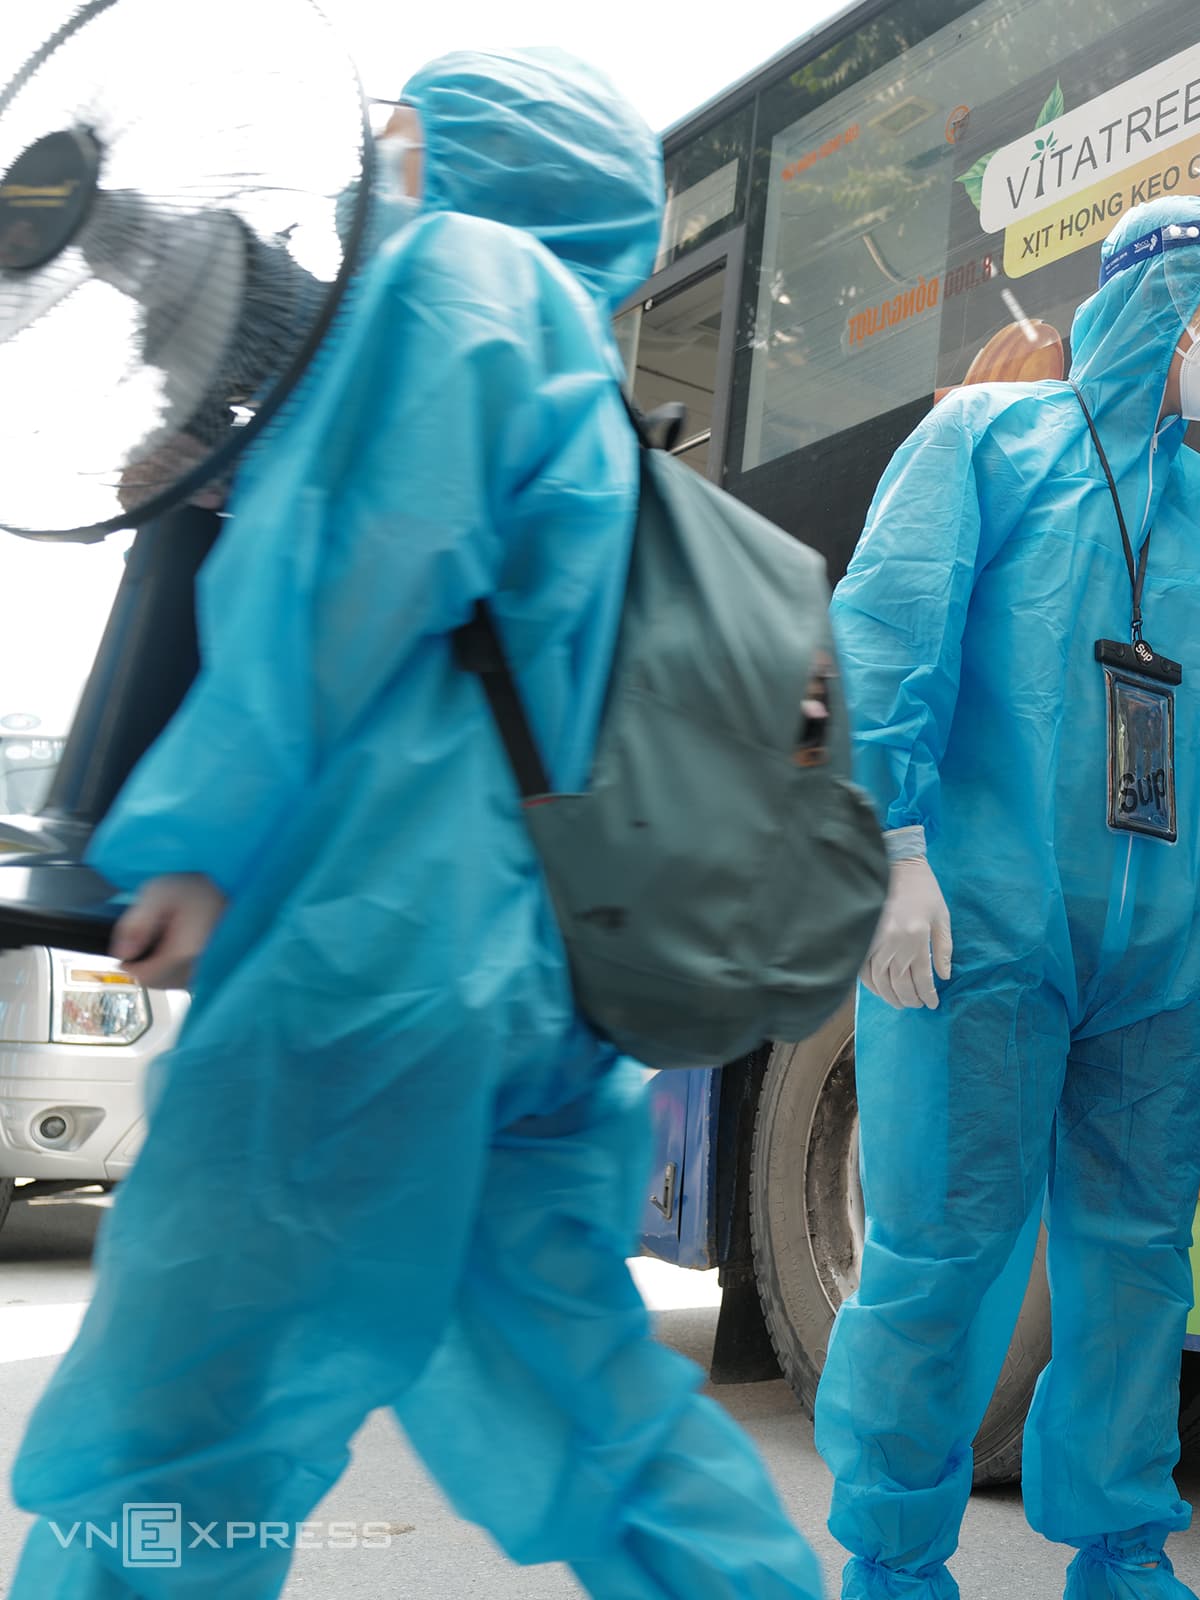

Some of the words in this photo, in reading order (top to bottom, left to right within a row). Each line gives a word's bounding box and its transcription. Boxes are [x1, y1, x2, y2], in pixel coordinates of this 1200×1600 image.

[1020, 223, 1055, 260] XỊT
[1059, 191, 1125, 241] HỌNG
[1130, 165, 1181, 209] KEO
[1135, 642, 1154, 663] Sup
[1118, 767, 1167, 814] Sup
